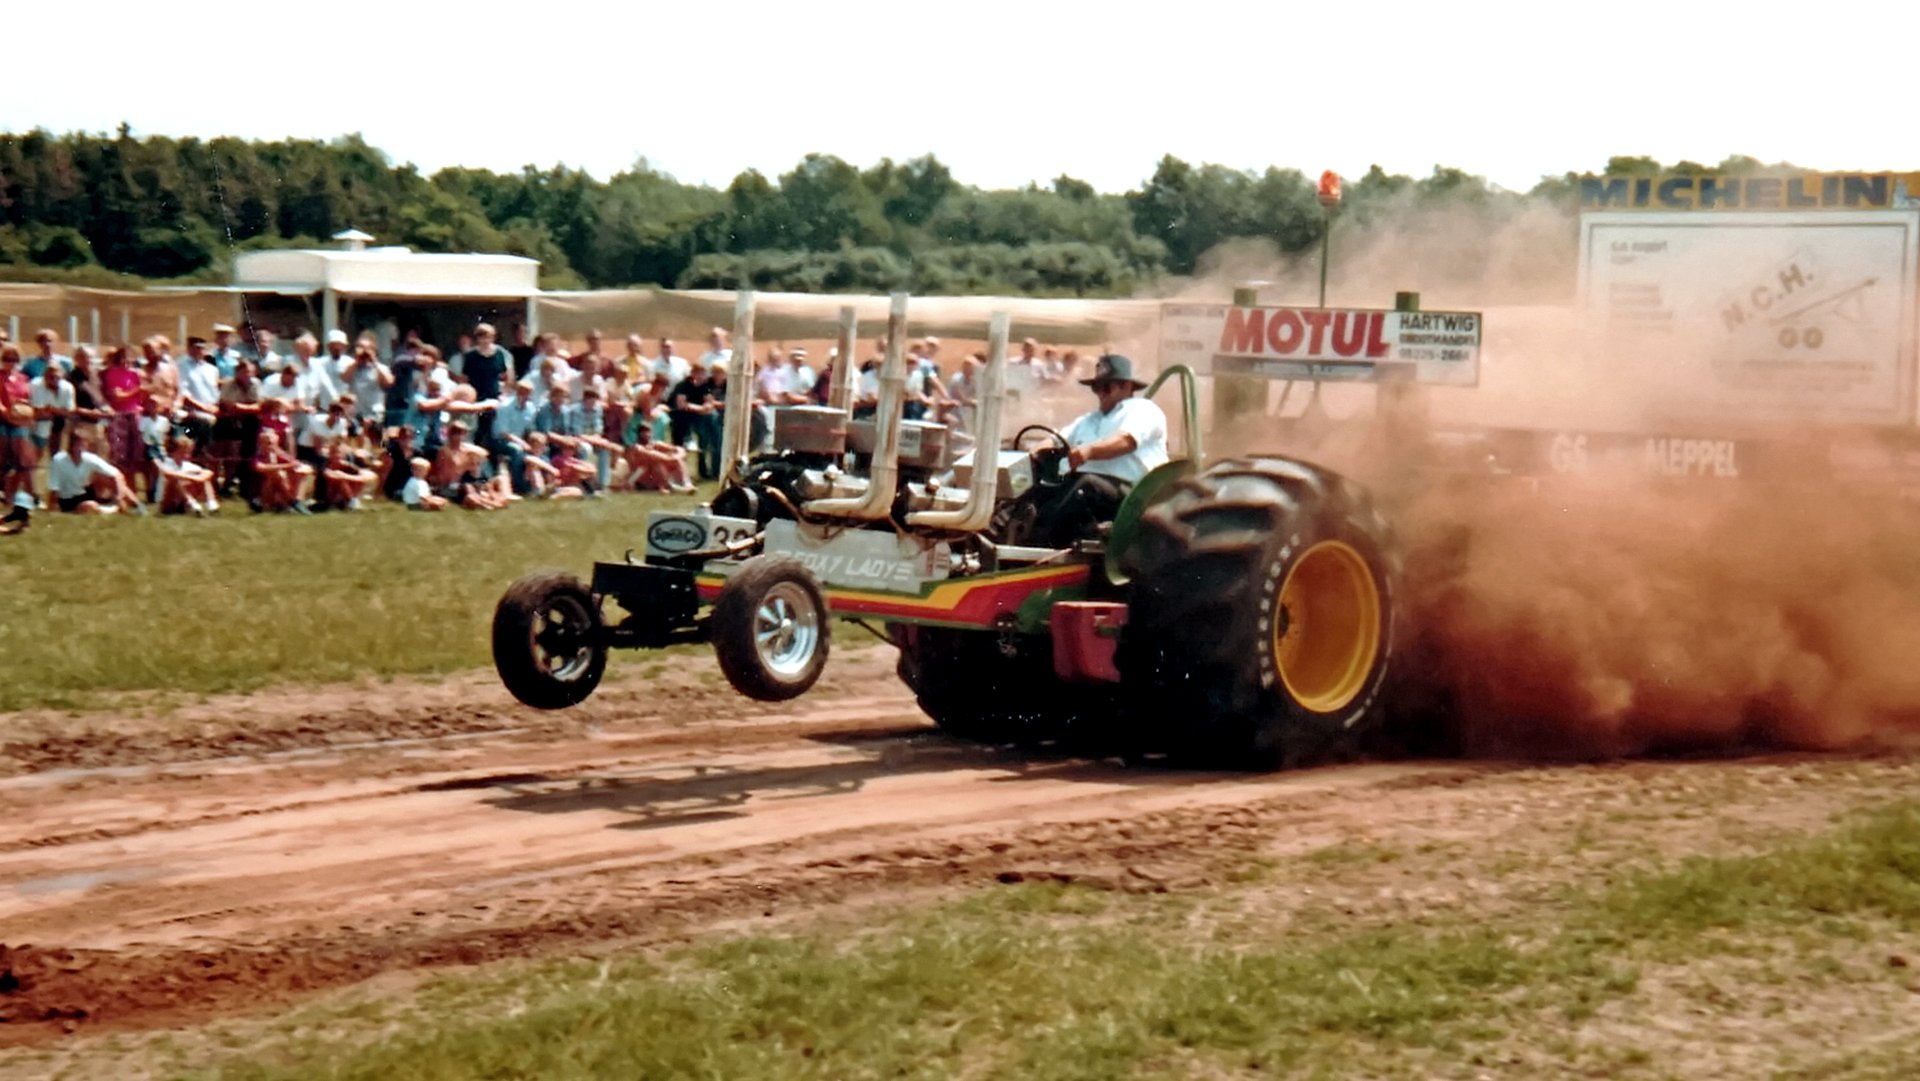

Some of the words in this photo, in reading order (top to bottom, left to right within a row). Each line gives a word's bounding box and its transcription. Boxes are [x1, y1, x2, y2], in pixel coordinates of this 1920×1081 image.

[1580, 176, 1888, 207] MICHELIN
[1220, 309, 1391, 358] MOTUL
[1400, 313, 1475, 332] HARTWIG
[1646, 437, 1740, 477] MEPPEL
[845, 557, 899, 580] LADY
